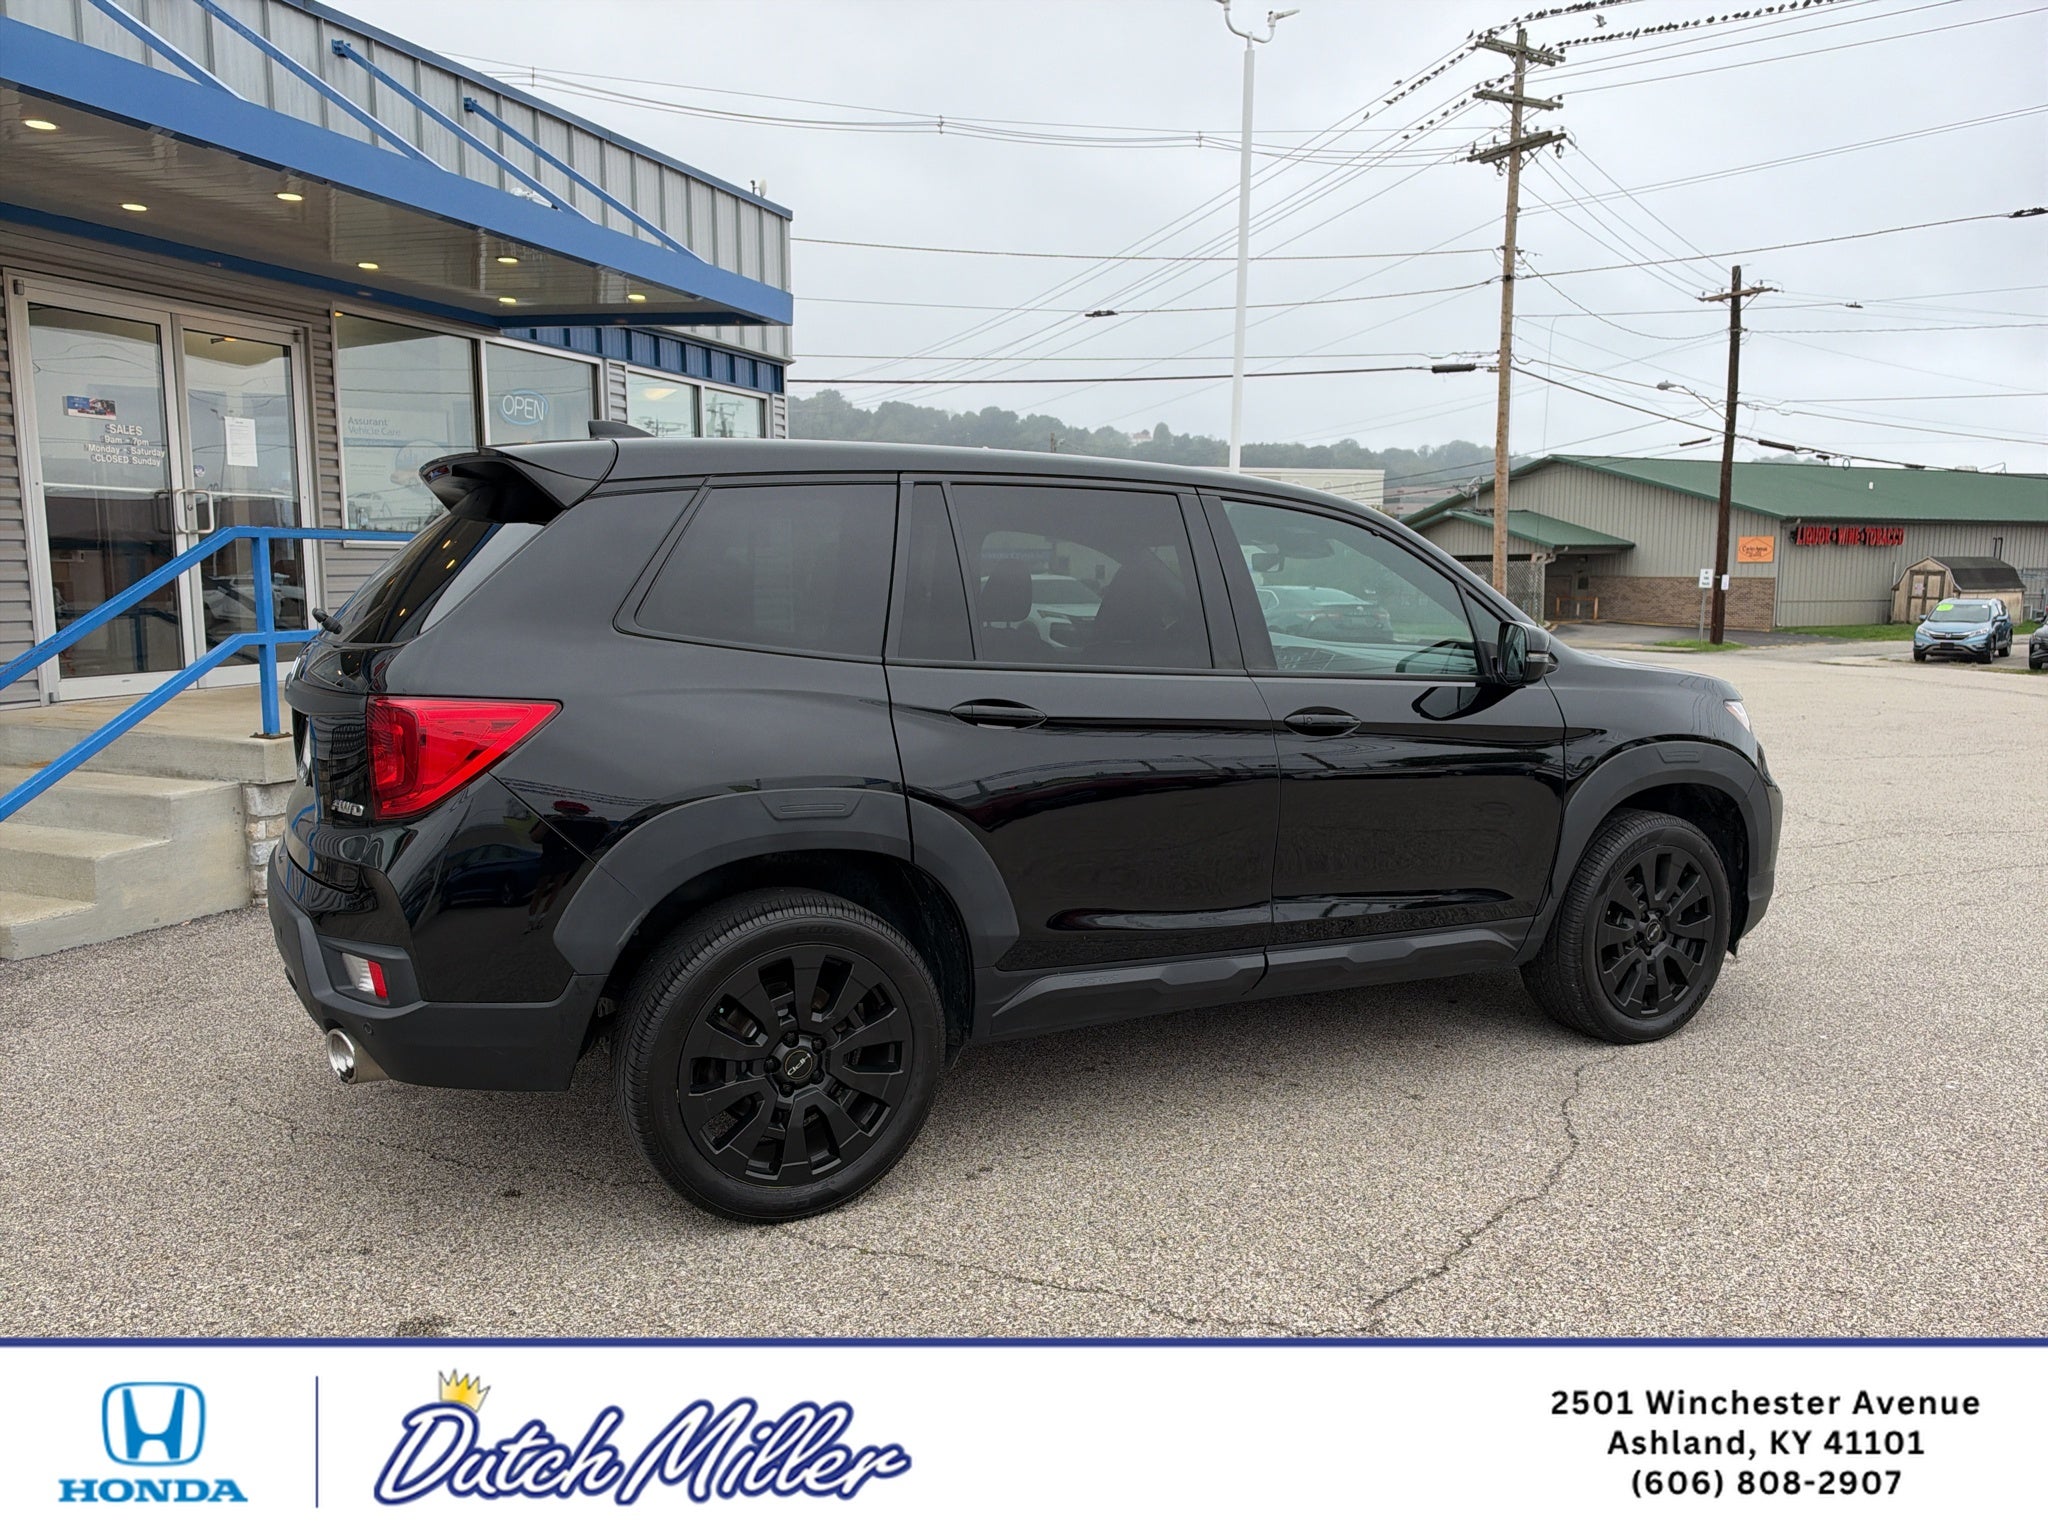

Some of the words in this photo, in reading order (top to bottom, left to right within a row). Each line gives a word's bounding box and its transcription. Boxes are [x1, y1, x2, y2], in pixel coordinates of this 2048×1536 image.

[502, 395, 544, 420] OPEN
[348, 416, 388, 426] Assurant
[109, 423, 143, 435] SALES
[348, 425, 380, 435] Vehicle
[381, 427, 401, 437] Care
[104, 435, 122, 444] 9am
[133, 437, 149, 446] 7pm
[88, 443, 120, 454] Monday
[131, 447, 165, 458] Saturday
[95, 454, 129, 464] CLOSED
[132, 456, 160, 467] Sunday
[1796, 526, 1831, 547] LIQUOR
[1838, 526, 1860, 546] WINE
[1864, 526, 1904, 546] TOBACCO
[331, 799, 364, 817] AWD
